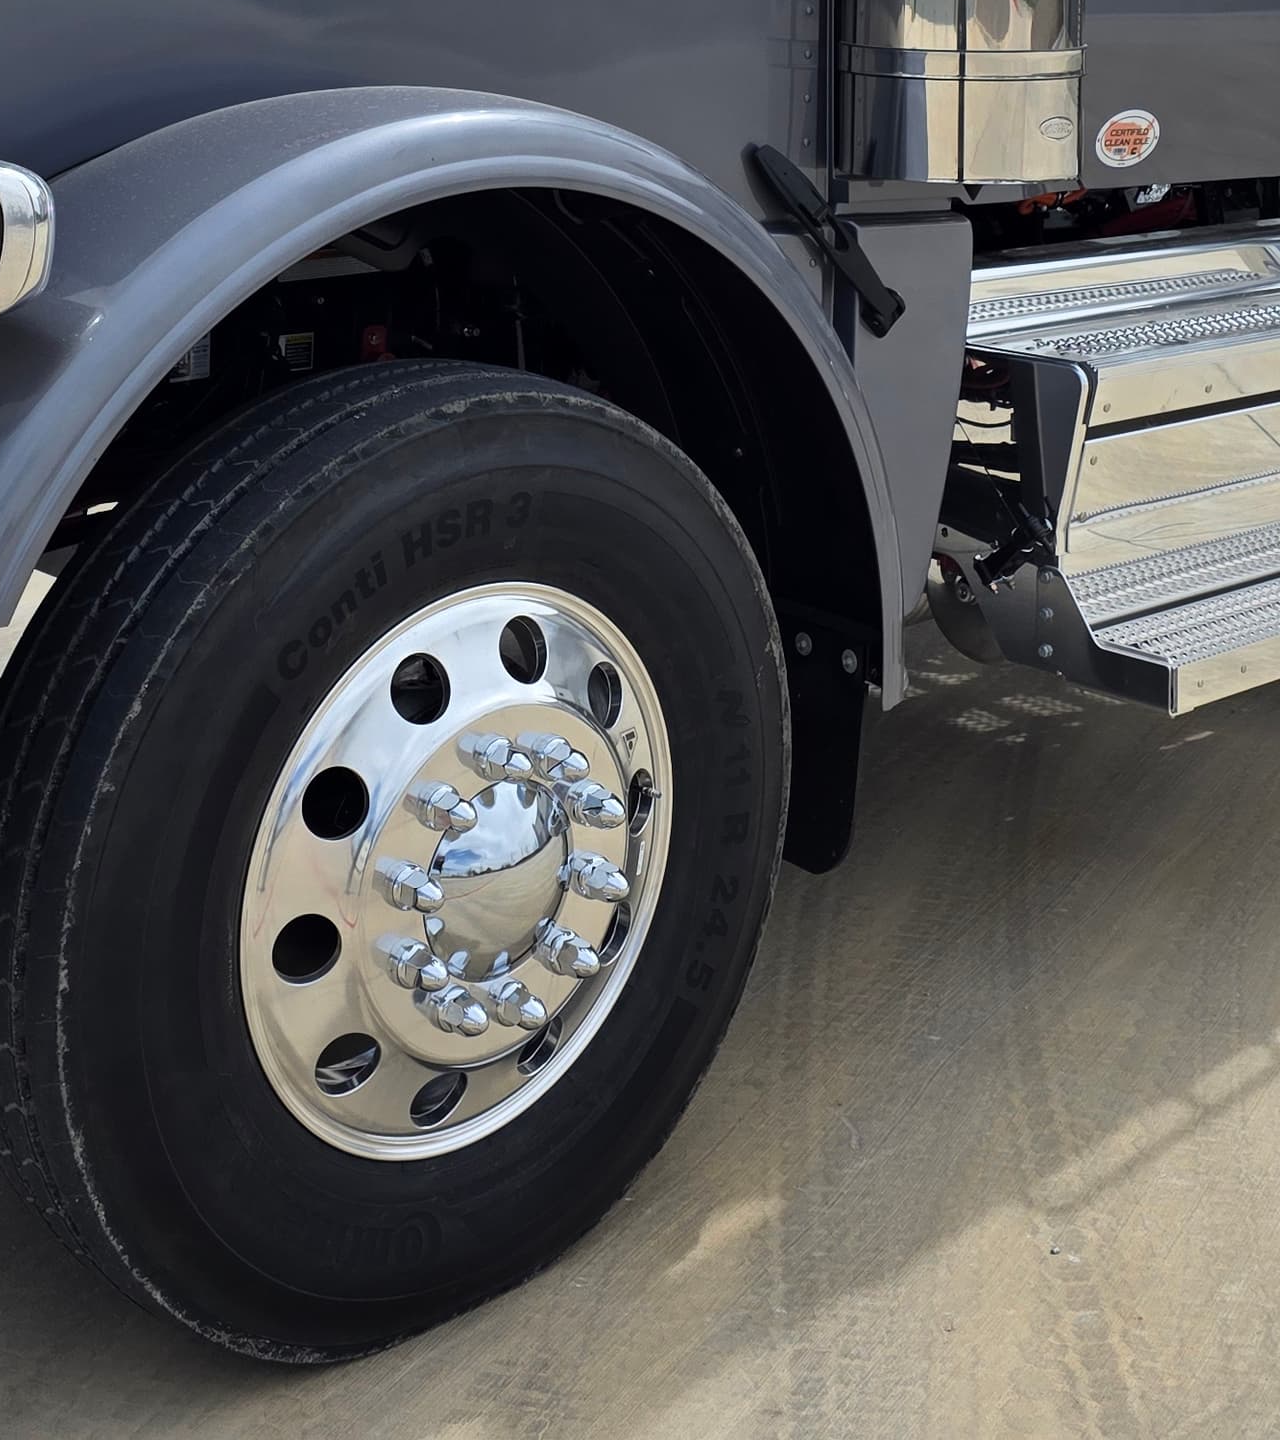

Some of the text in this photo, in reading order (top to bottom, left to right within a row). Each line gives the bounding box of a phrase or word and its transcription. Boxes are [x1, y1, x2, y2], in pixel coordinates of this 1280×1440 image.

[1105, 136, 1150, 147] CLEAN IDLE
[1110, 128, 1149, 137] CERTIFIED
[277, 491, 533, 681] Conti HSR 3
[685, 873, 741, 993] 24.5
